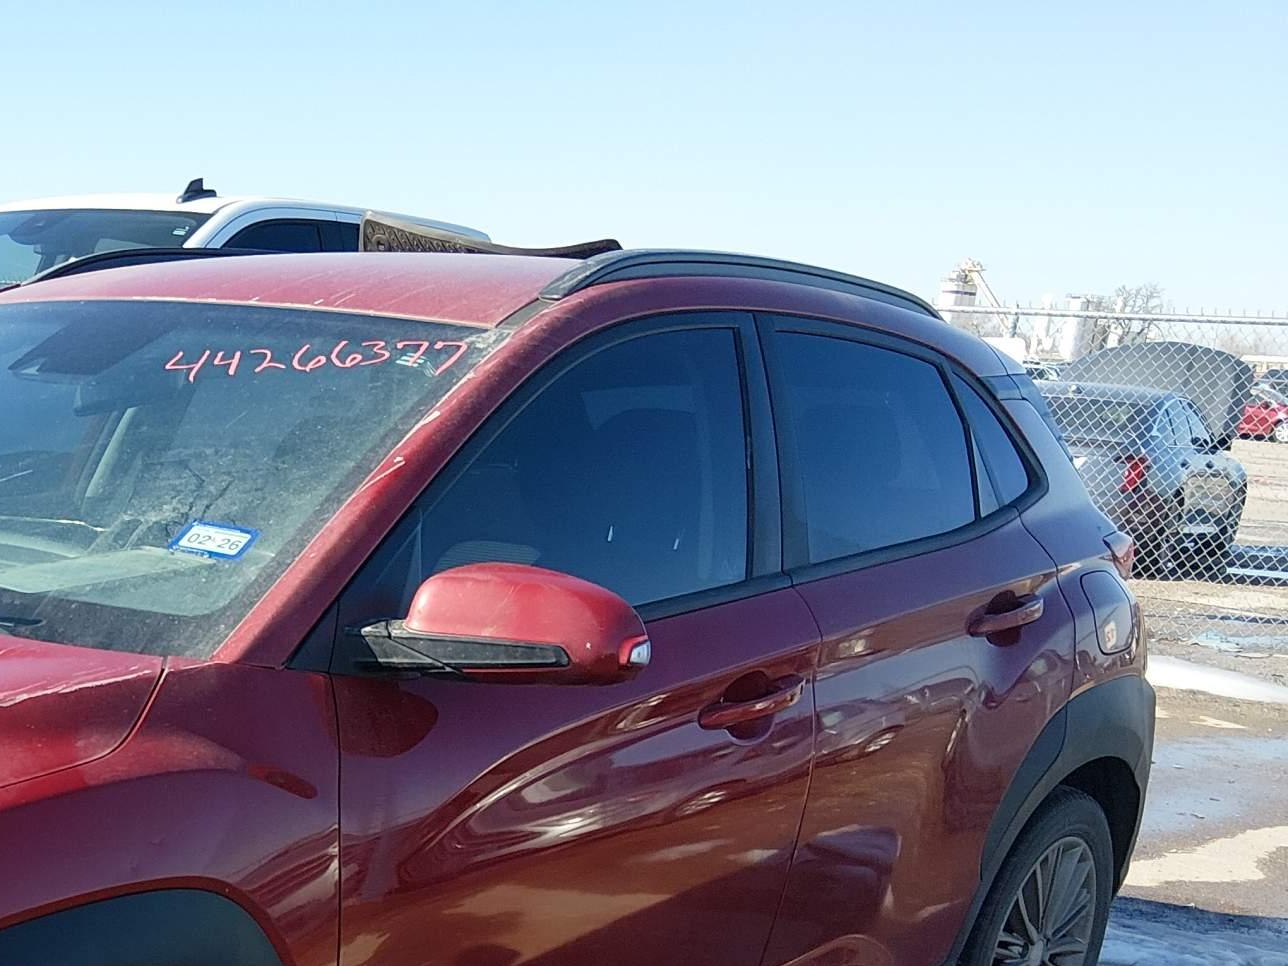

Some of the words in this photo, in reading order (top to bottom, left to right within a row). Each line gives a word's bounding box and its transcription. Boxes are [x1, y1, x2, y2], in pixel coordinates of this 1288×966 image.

[165, 340, 468, 382] 44266377
[187, 533, 212, 546] 02
[216, 538, 243, 551] 26
